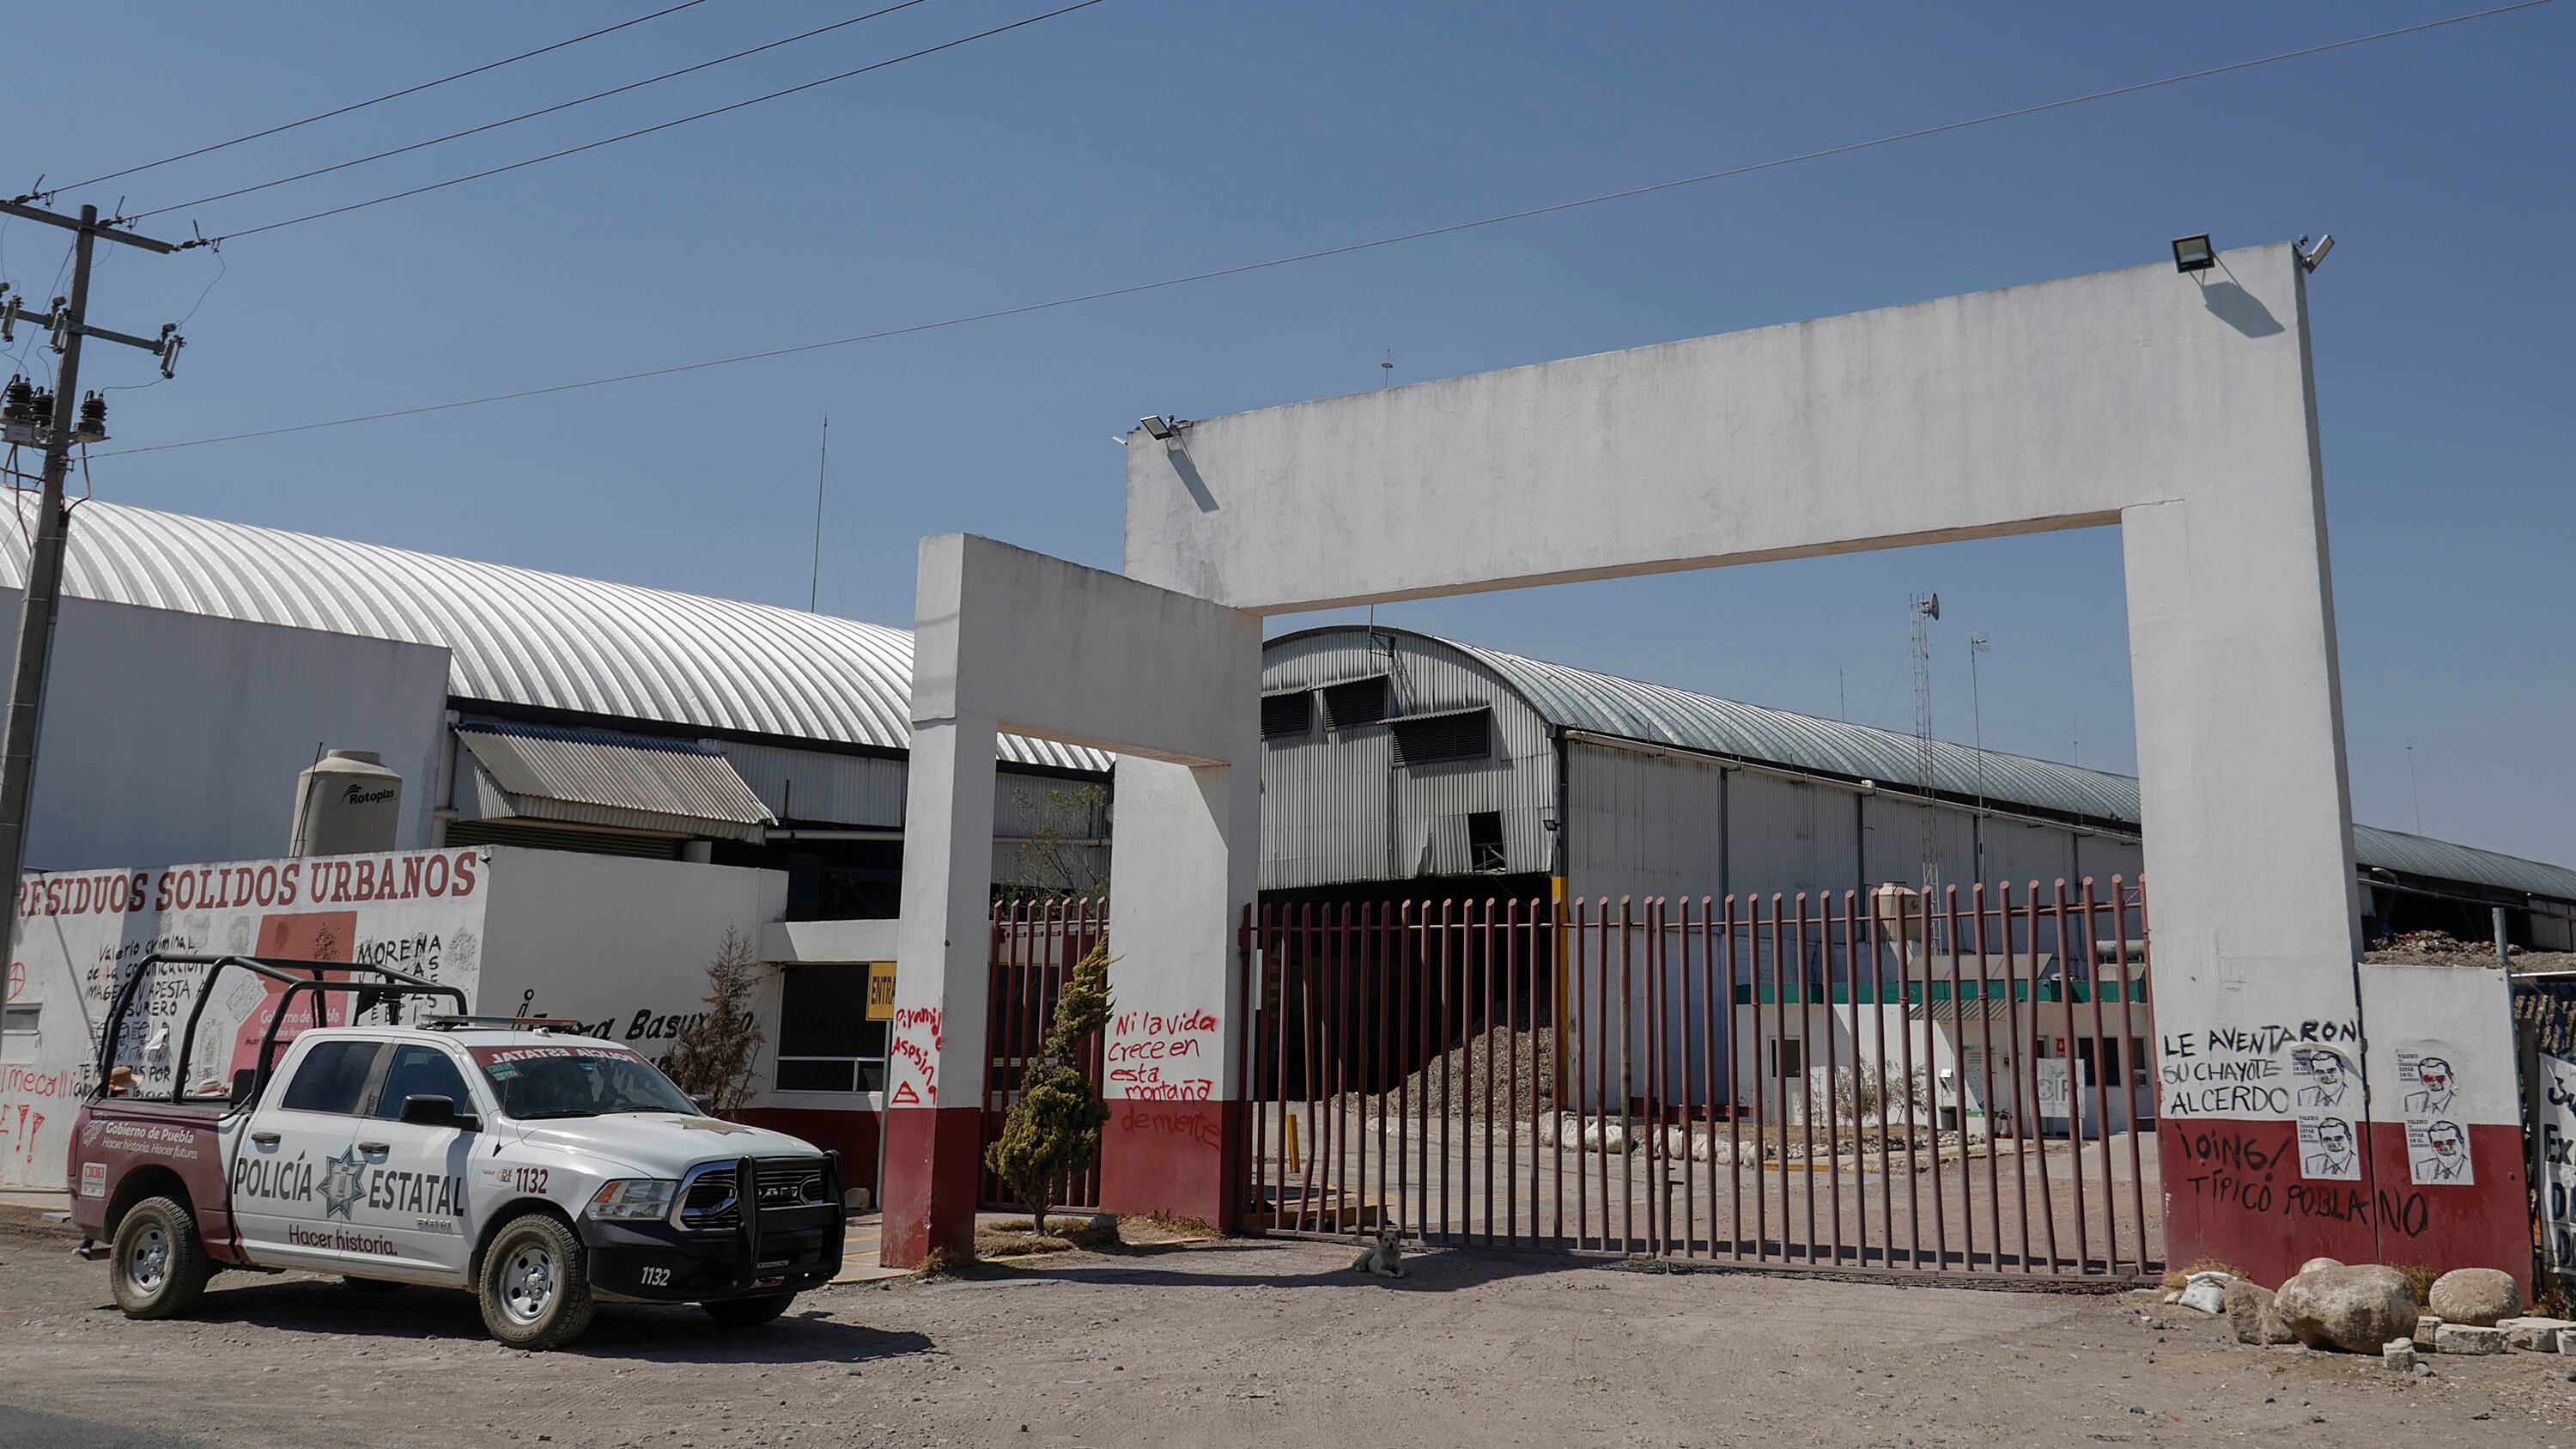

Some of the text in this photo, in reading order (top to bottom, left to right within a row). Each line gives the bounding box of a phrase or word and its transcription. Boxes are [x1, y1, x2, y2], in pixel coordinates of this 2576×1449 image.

[349, 788, 395, 806] Rotoplas
[155, 863, 301, 911] SOLIDOS
[311, 851, 477, 904] URBANOS
[99, 941, 140, 963] Valerio
[357, 934, 441, 964] MORENA
[87, 965, 100, 981] de
[1116, 1012, 1138, 1036] Ni
[1143, 1011, 1162, 1036] la
[1170, 1038, 1200, 1057] en
[2164, 1018, 2358, 1057] LE AVENTARON
[1109, 1062, 1161, 1083] esta
[2162, 1058, 2282, 1084] SU CHAYOTE
[106, 1121, 195, 1144] Gobierno de Puebla
[102, 1136, 123, 1150] Hacer
[150, 1142, 173, 1155] Hacer
[234, 1149, 465, 1217] POLICÍA ESTATAL
[516, 1167, 550, 1195] 1132
[2187, 1168, 2428, 1238] TÍPICO POBLANO
[289, 1224, 398, 1257] Hacer historia.
[641, 1265, 671, 1287] 1132
